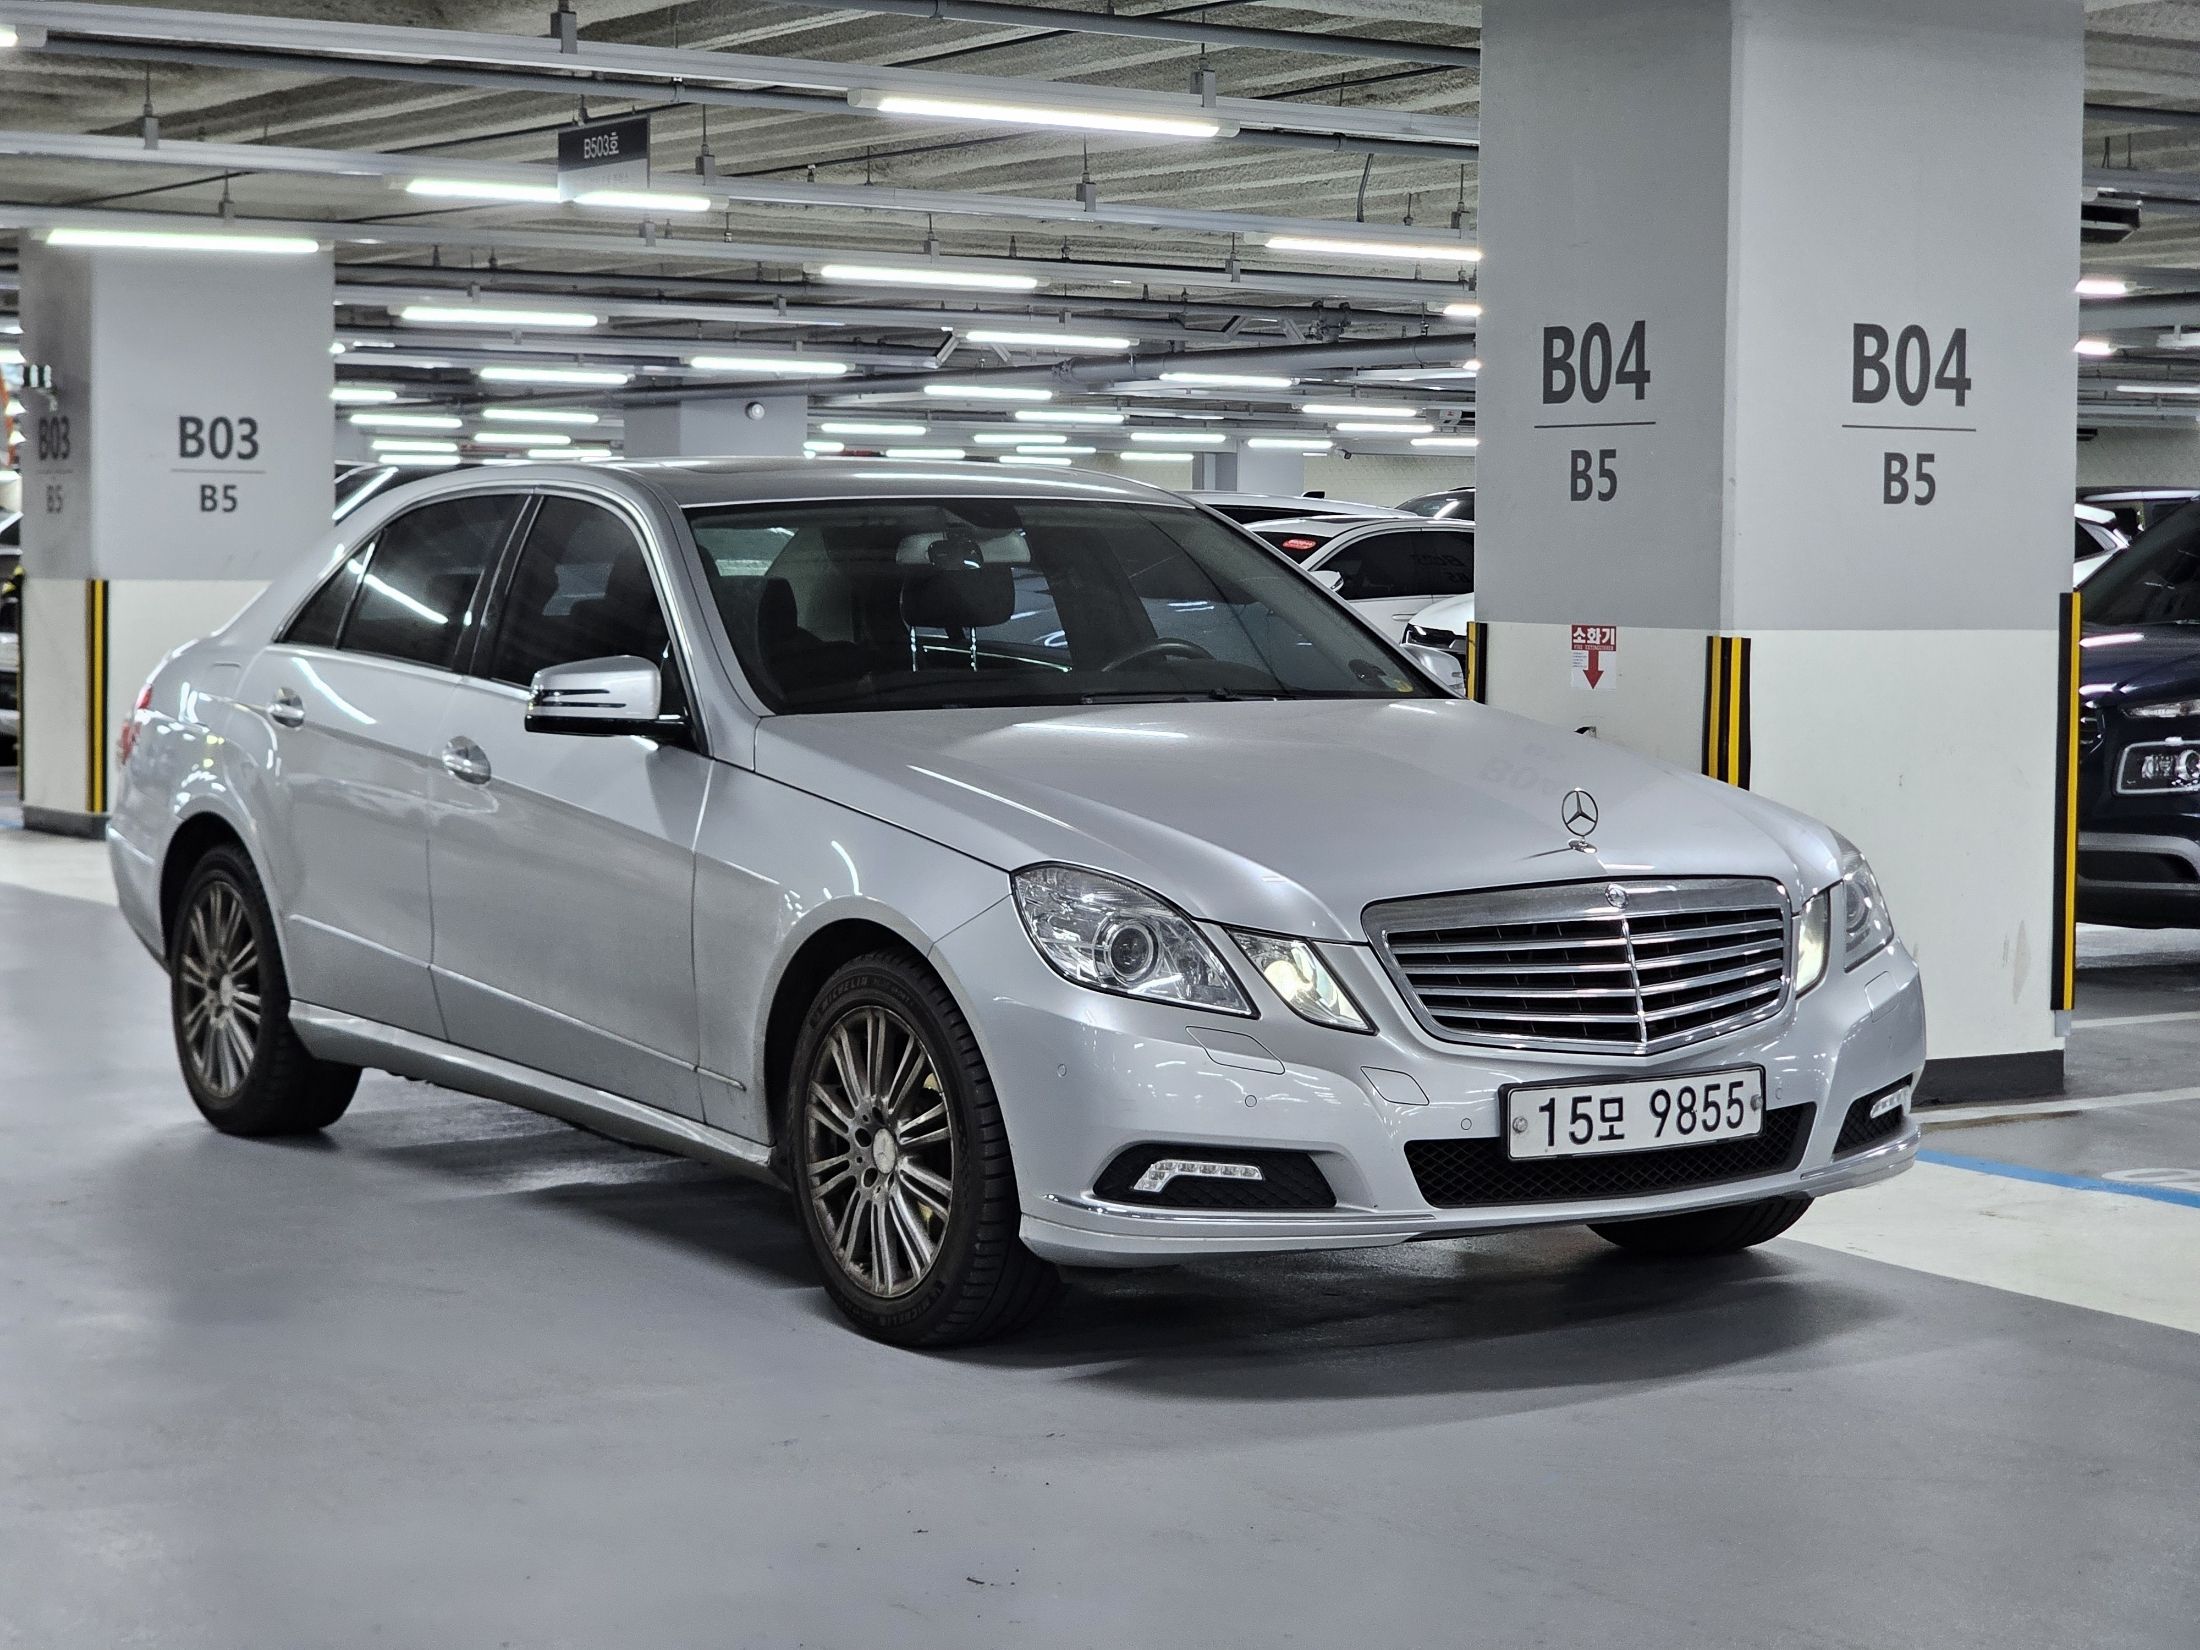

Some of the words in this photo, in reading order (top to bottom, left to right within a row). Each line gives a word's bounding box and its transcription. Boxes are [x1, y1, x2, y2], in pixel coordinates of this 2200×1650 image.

[583, 131, 619, 159] B503호
[1543, 320, 1651, 404] B04
[1852, 323, 1971, 407] B04
[38, 416, 71, 461] B03
[178, 416, 259, 460] B03
[1570, 449, 1618, 501] B5
[1883, 452, 1936, 505] B5
[46, 485, 63, 514] B5
[200, 484, 238, 513] B5
[1573, 627, 1615, 645] 소화기
[1539, 1095, 1625, 1147] 15모
[1649, 1081, 1744, 1138] 9855
